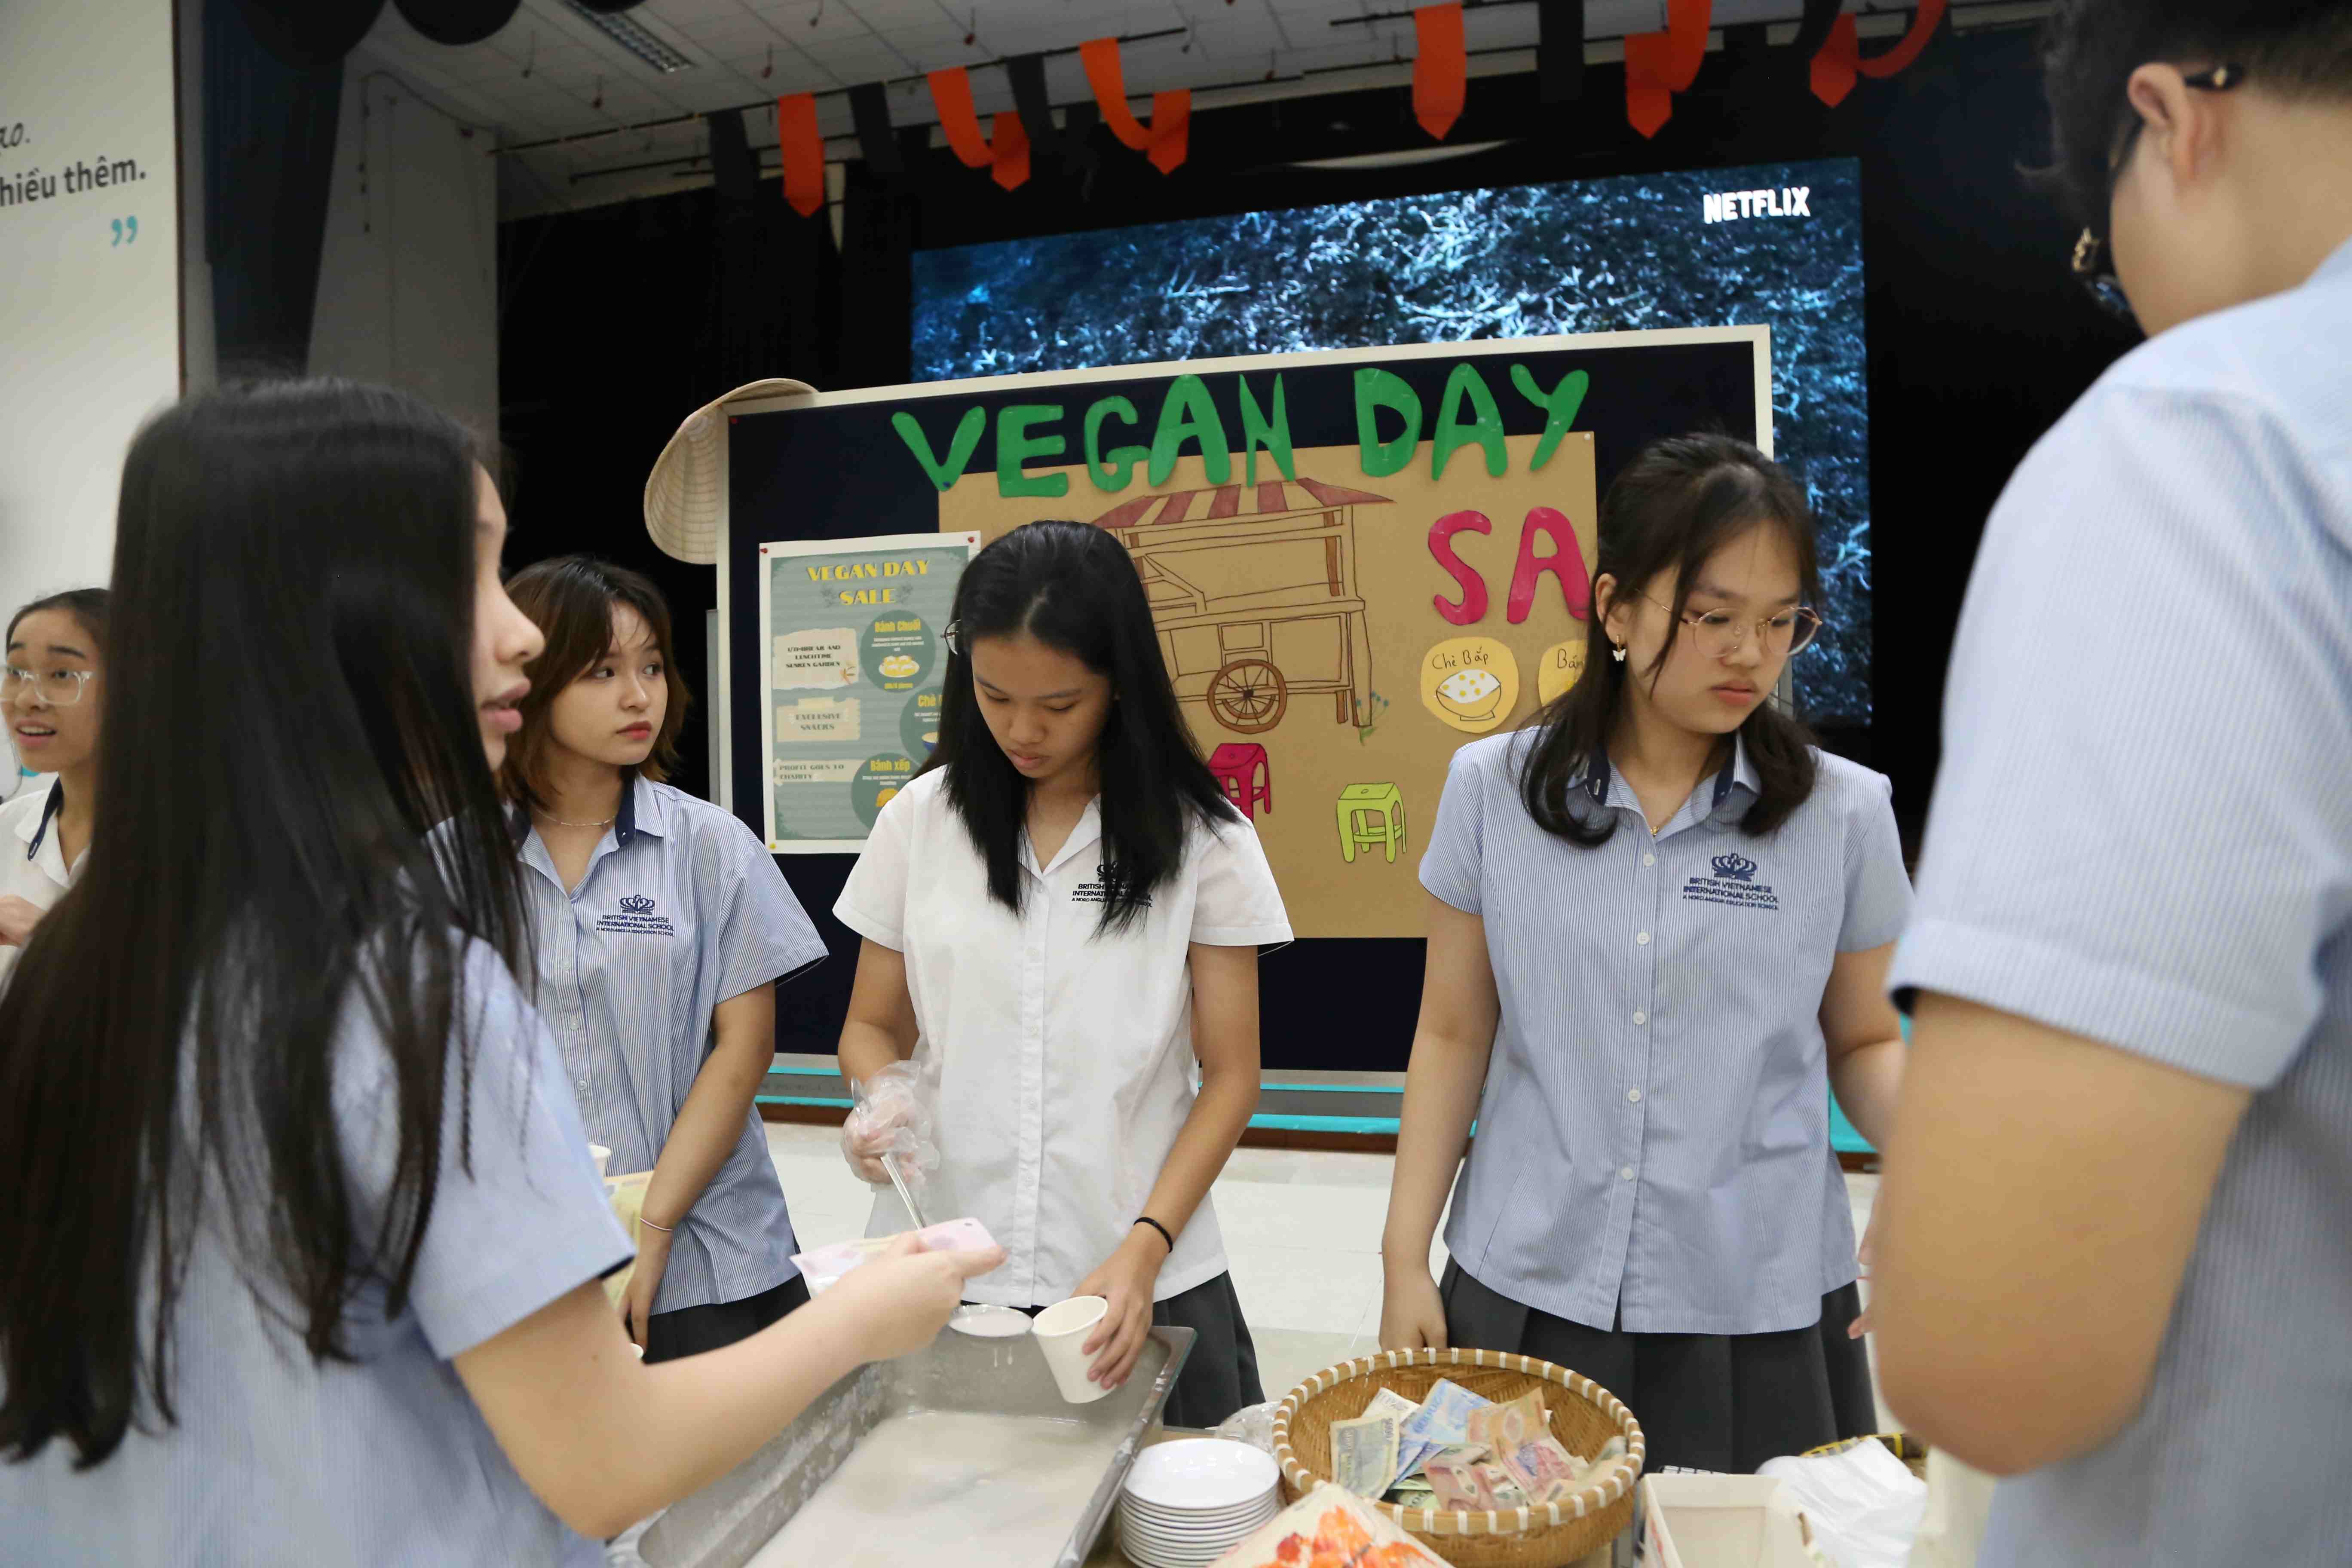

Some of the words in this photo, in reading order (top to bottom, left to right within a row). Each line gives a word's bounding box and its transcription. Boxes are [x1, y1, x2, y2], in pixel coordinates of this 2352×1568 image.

[64, 155, 147, 194] thêm.
[1703, 186, 1811, 224] NETFLIX
[891, 372, 1295, 497] VEGAN
[1354, 363, 1589, 482] DAY
[806, 563, 878, 582] VEGAN
[882, 560, 929, 577] DAY
[839, 588, 896, 605] SALE
[1432, 653, 1458, 669] Chè
[1689, 878, 1720, 886] BRITISH
[1683, 886, 1743, 899] INTERNATIONAL
[1746, 894, 1778, 903] SCHOOL
[597, 920, 647, 929] INTERNATIONAL
